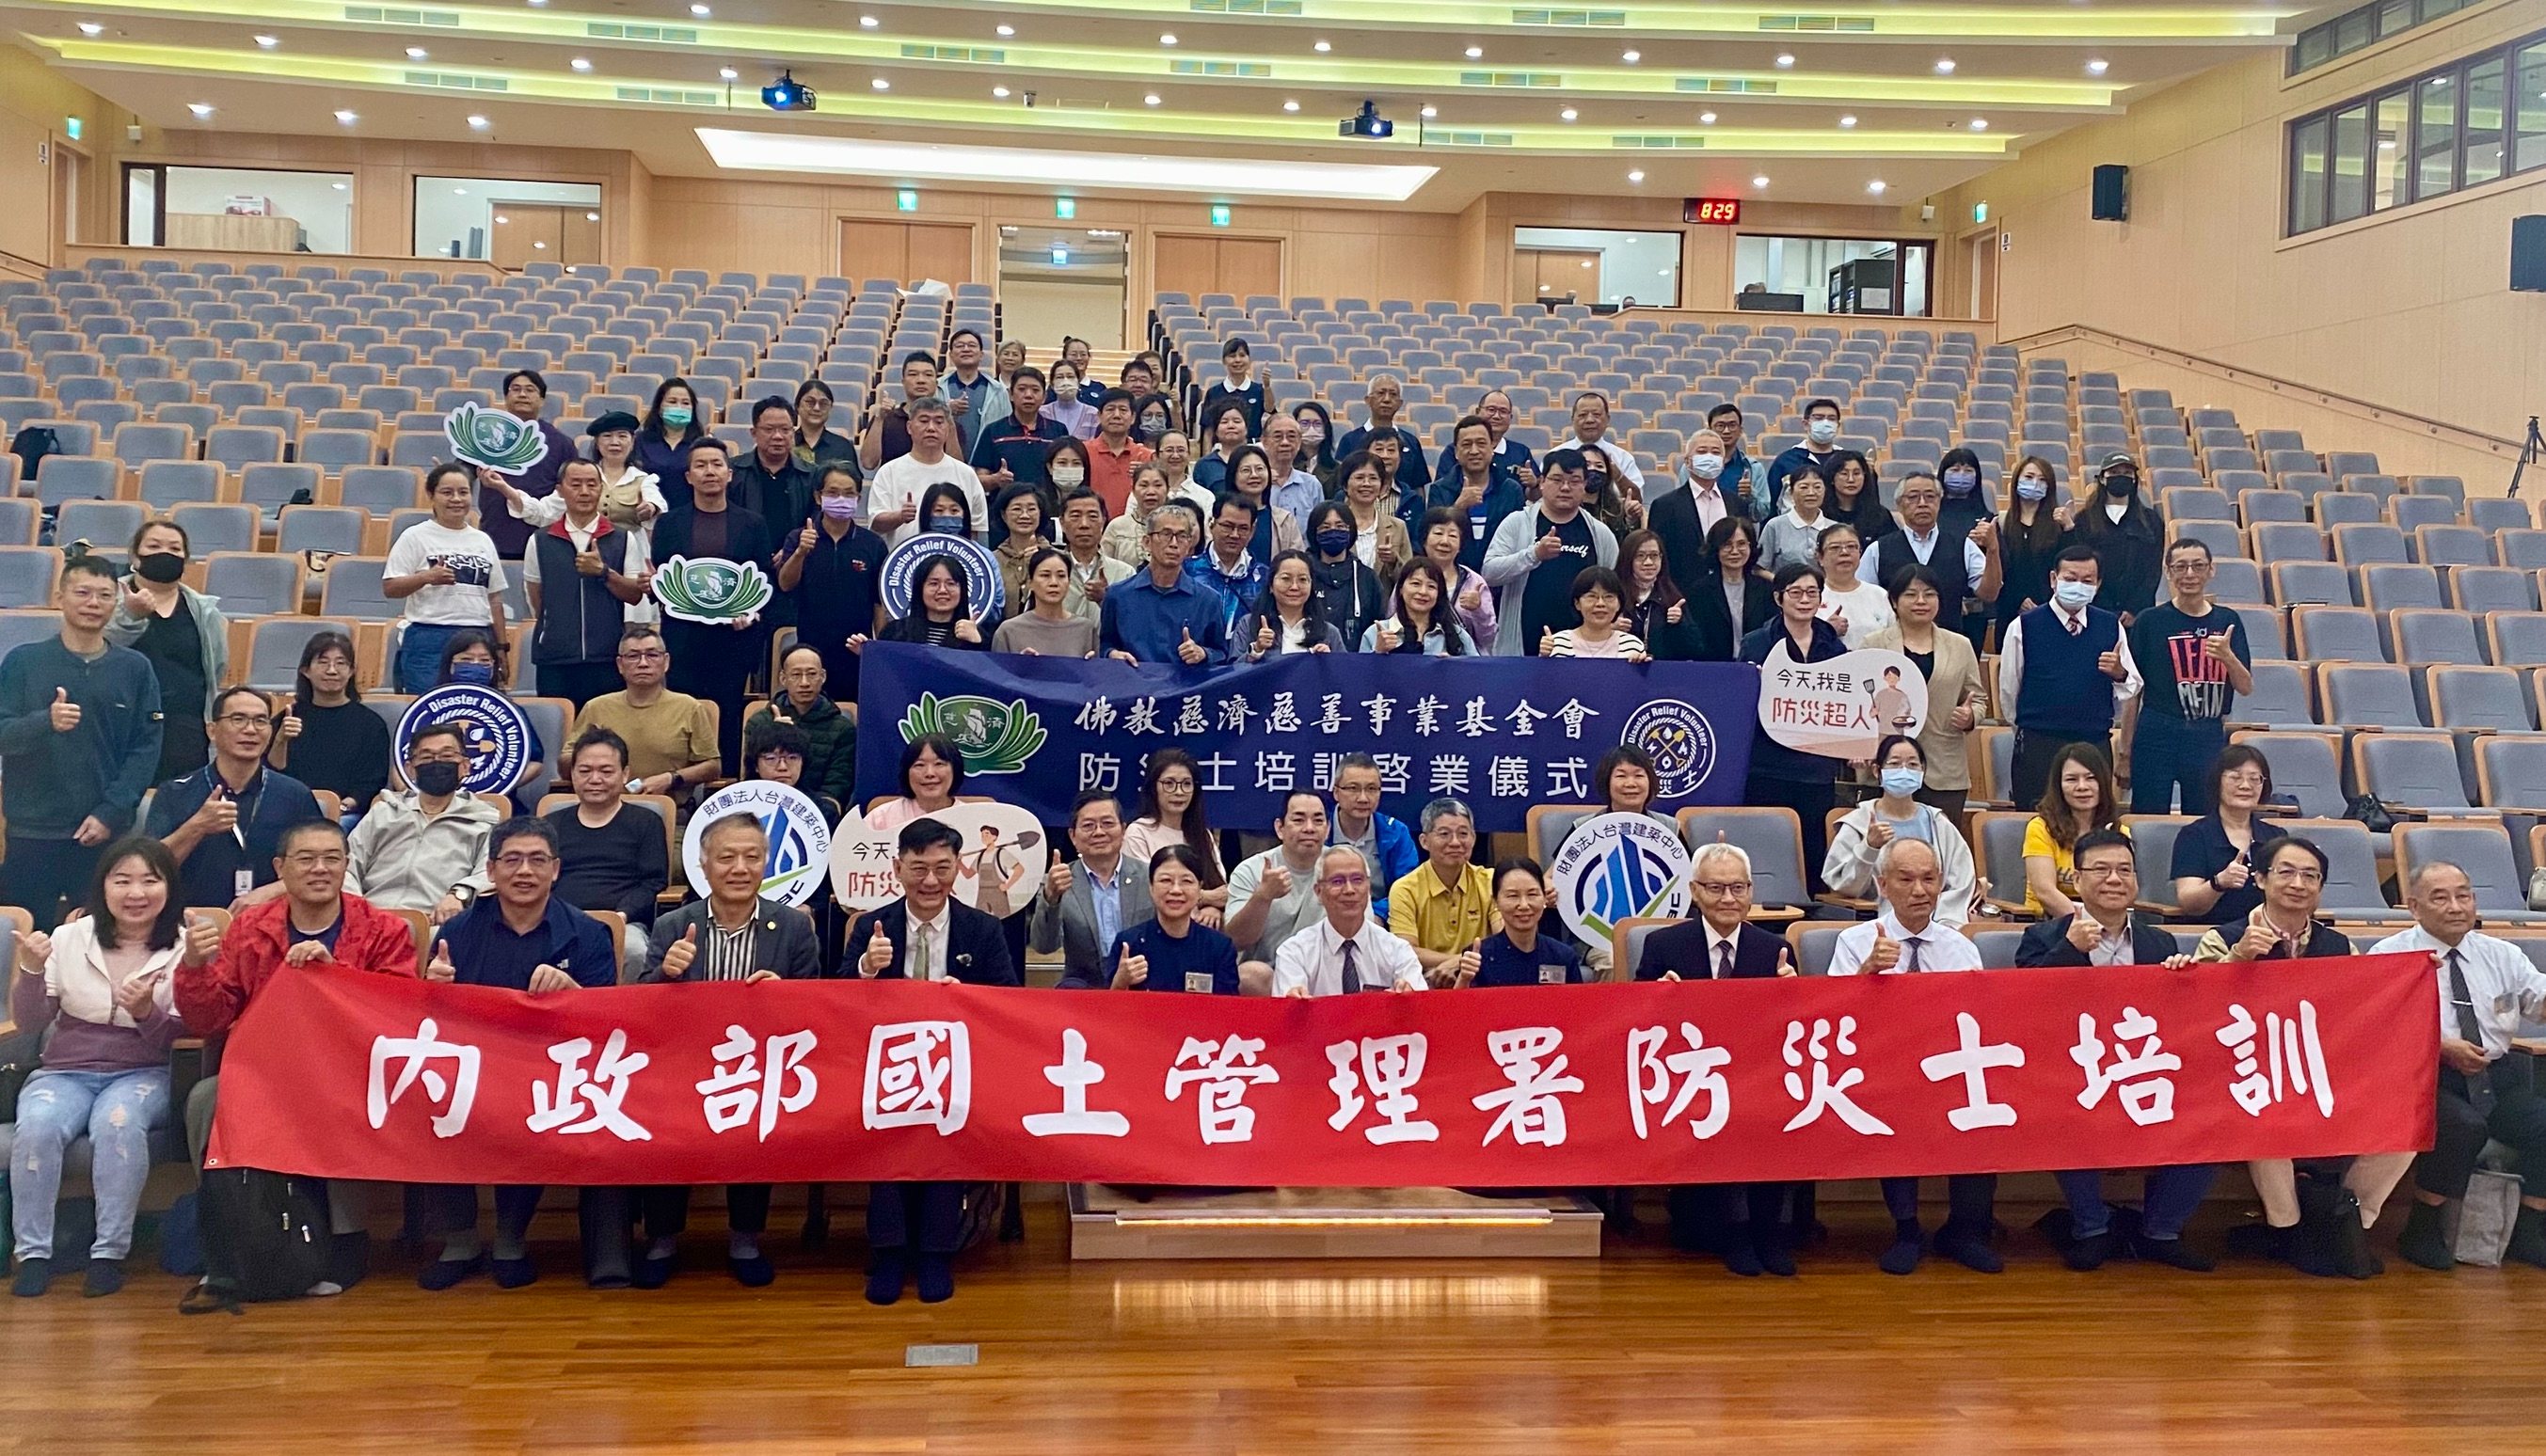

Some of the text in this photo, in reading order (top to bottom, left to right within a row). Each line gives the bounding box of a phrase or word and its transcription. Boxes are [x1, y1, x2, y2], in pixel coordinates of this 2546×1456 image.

[888, 541, 984, 586] Disaster Relief Volunteer
[1776, 669, 1853, 693] 今天,我是
[1074, 691, 1599, 739] 佛教慈濟慈善事業基金會
[1627, 705, 1708, 747] Disaster Relief Volunteer
[1773, 697, 1870, 730] 防災超人
[428, 694, 520, 780] Disaster Relief Volunteer
[1079, 752, 1588, 799] 防士培訓啓業儀式
[1659, 770, 1697, 794] 災士
[703, 789, 829, 854] 財團法人台灣建築中心
[1557, 822, 1683, 876] 財團法人台灣建築中心
